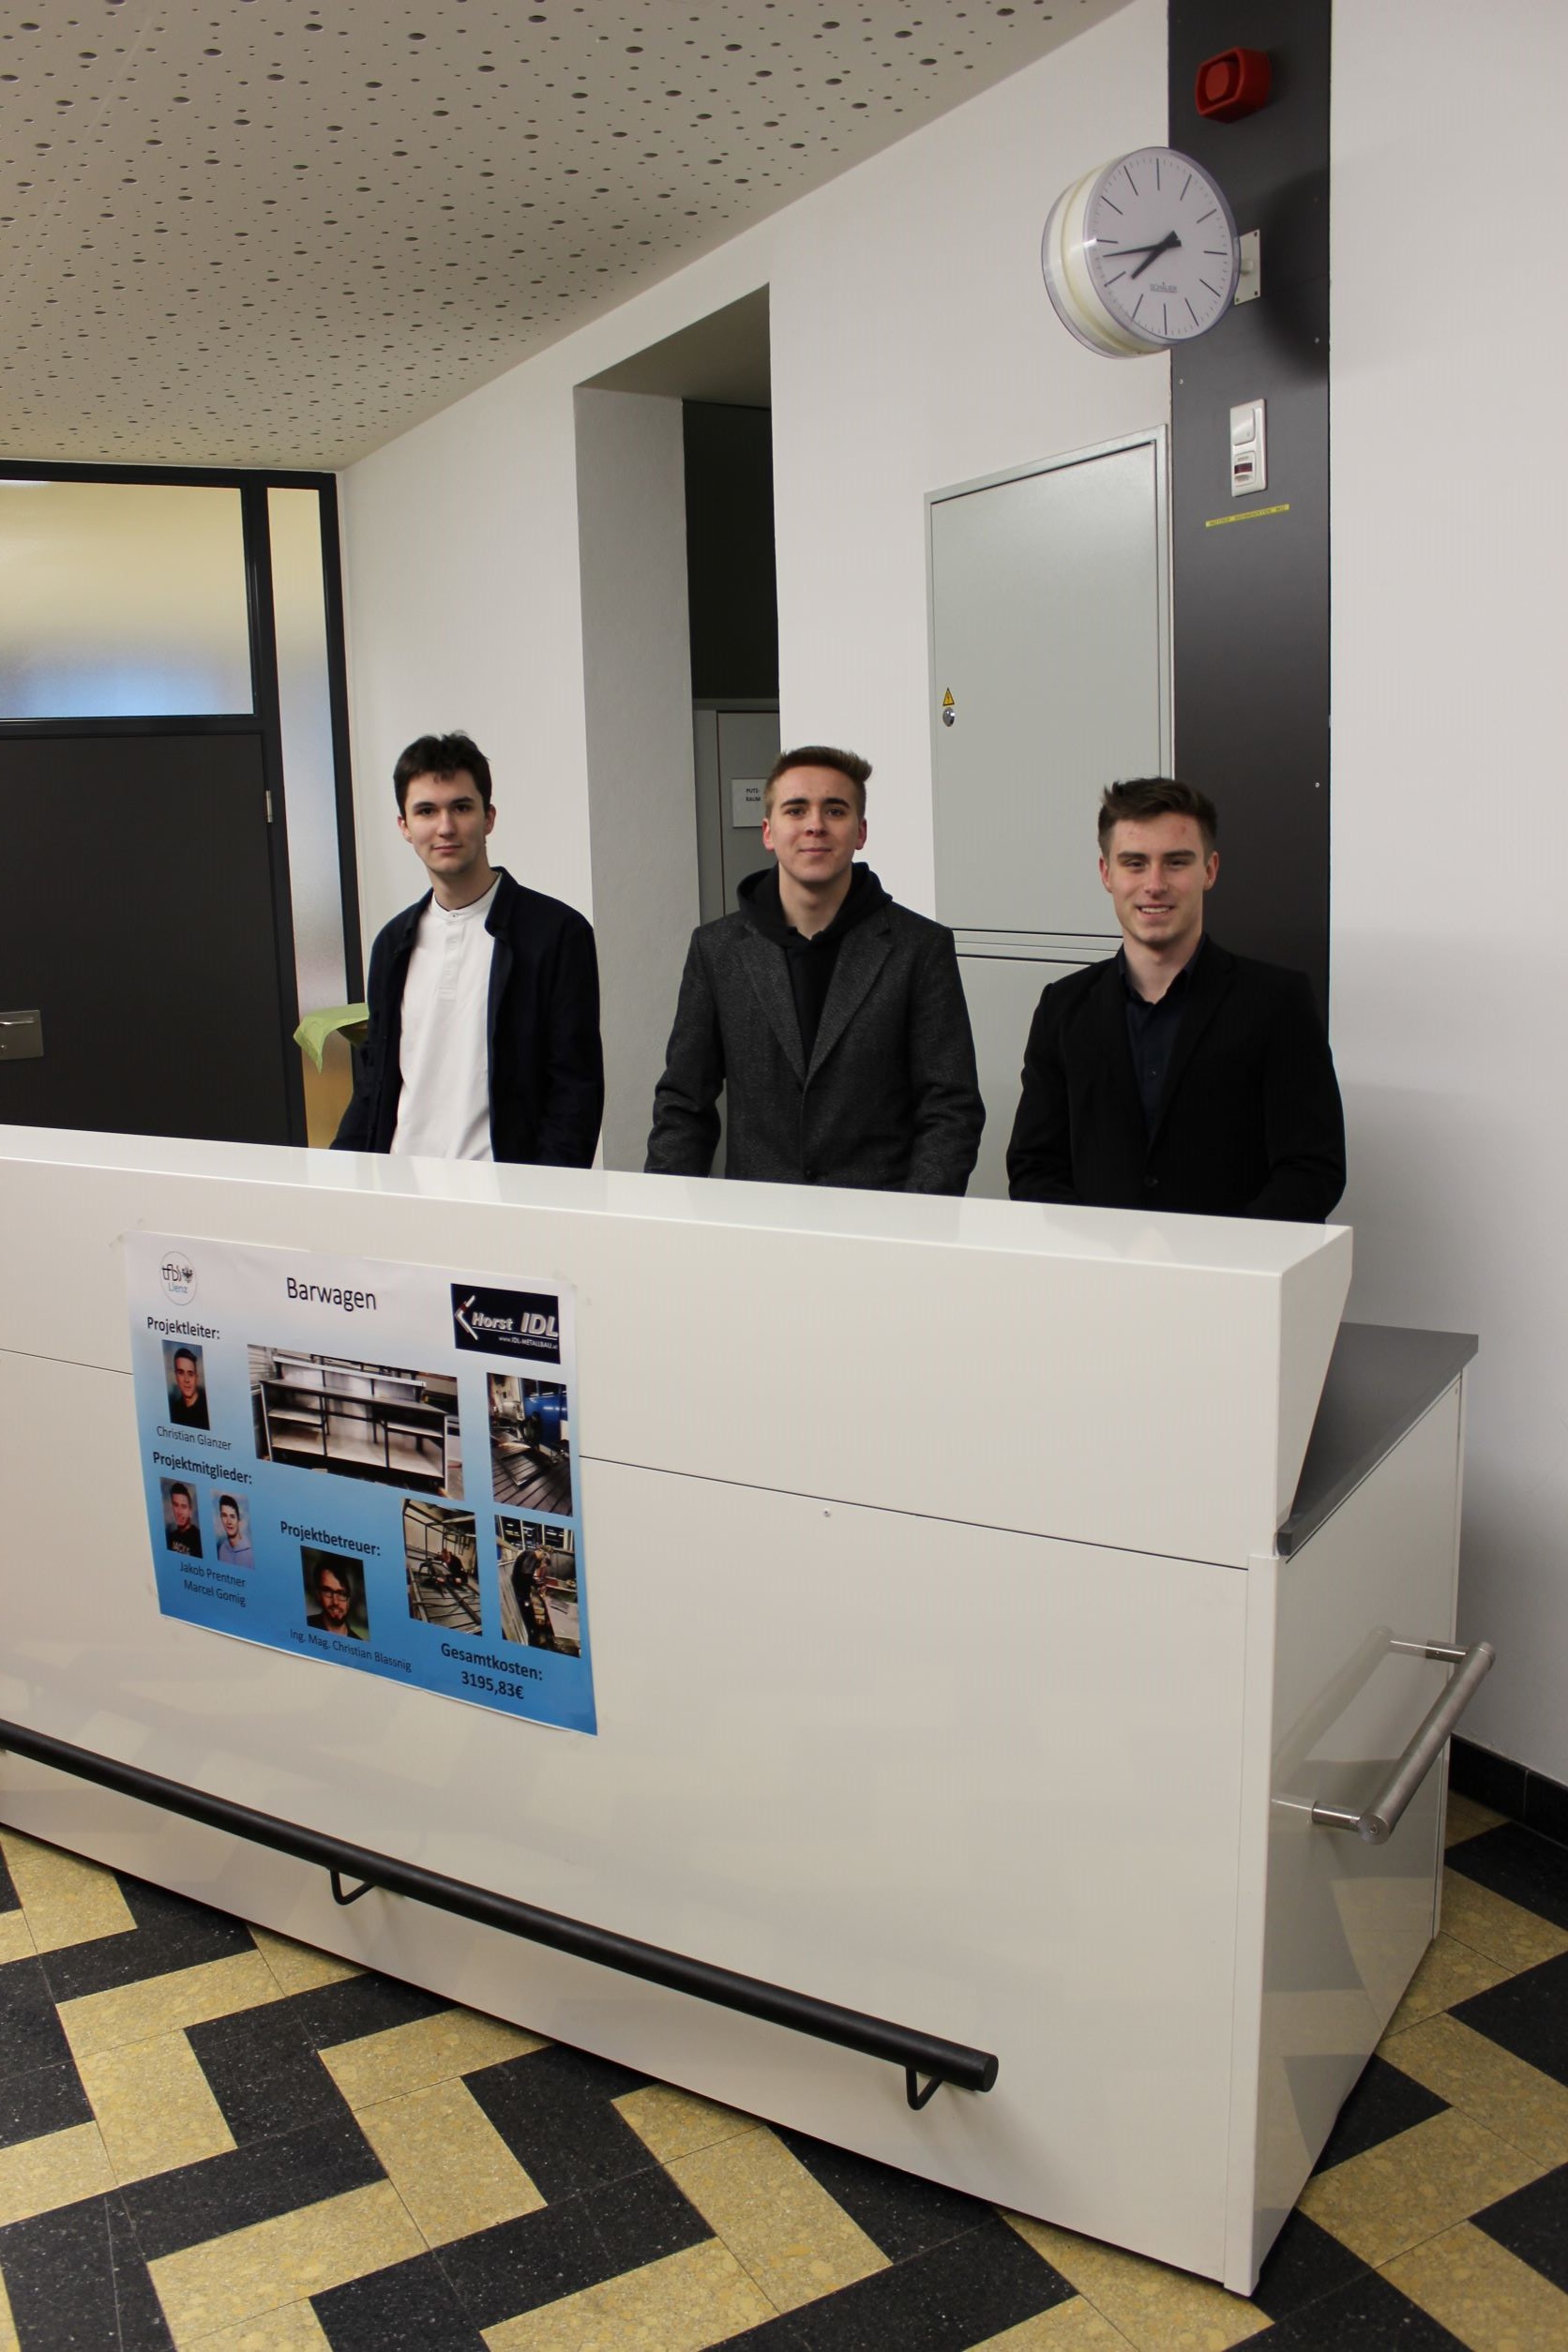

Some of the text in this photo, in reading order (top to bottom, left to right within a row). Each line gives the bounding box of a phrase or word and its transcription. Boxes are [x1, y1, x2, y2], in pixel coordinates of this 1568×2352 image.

[286, 1276, 377, 1312] Barwagen
[146, 1316, 221, 1340] Projektleiter:
[472, 1311, 559, 1337] Horst IDL
[156, 1425, 233, 1451] Christian Glanzer
[153, 1451, 253, 1485] Projektmitglieder:
[280, 1521, 382, 1557] Projektbetreuer:
[180, 1561, 247, 1588] Jakob Prentner
[183, 1579, 215, 1597] Marcel
[290, 1628, 413, 1673] Ing. Mag. Christian Blassnig
[441, 1642, 544, 1681] Gesamtkosten:
[460, 1670, 525, 1700] 3195,83€
